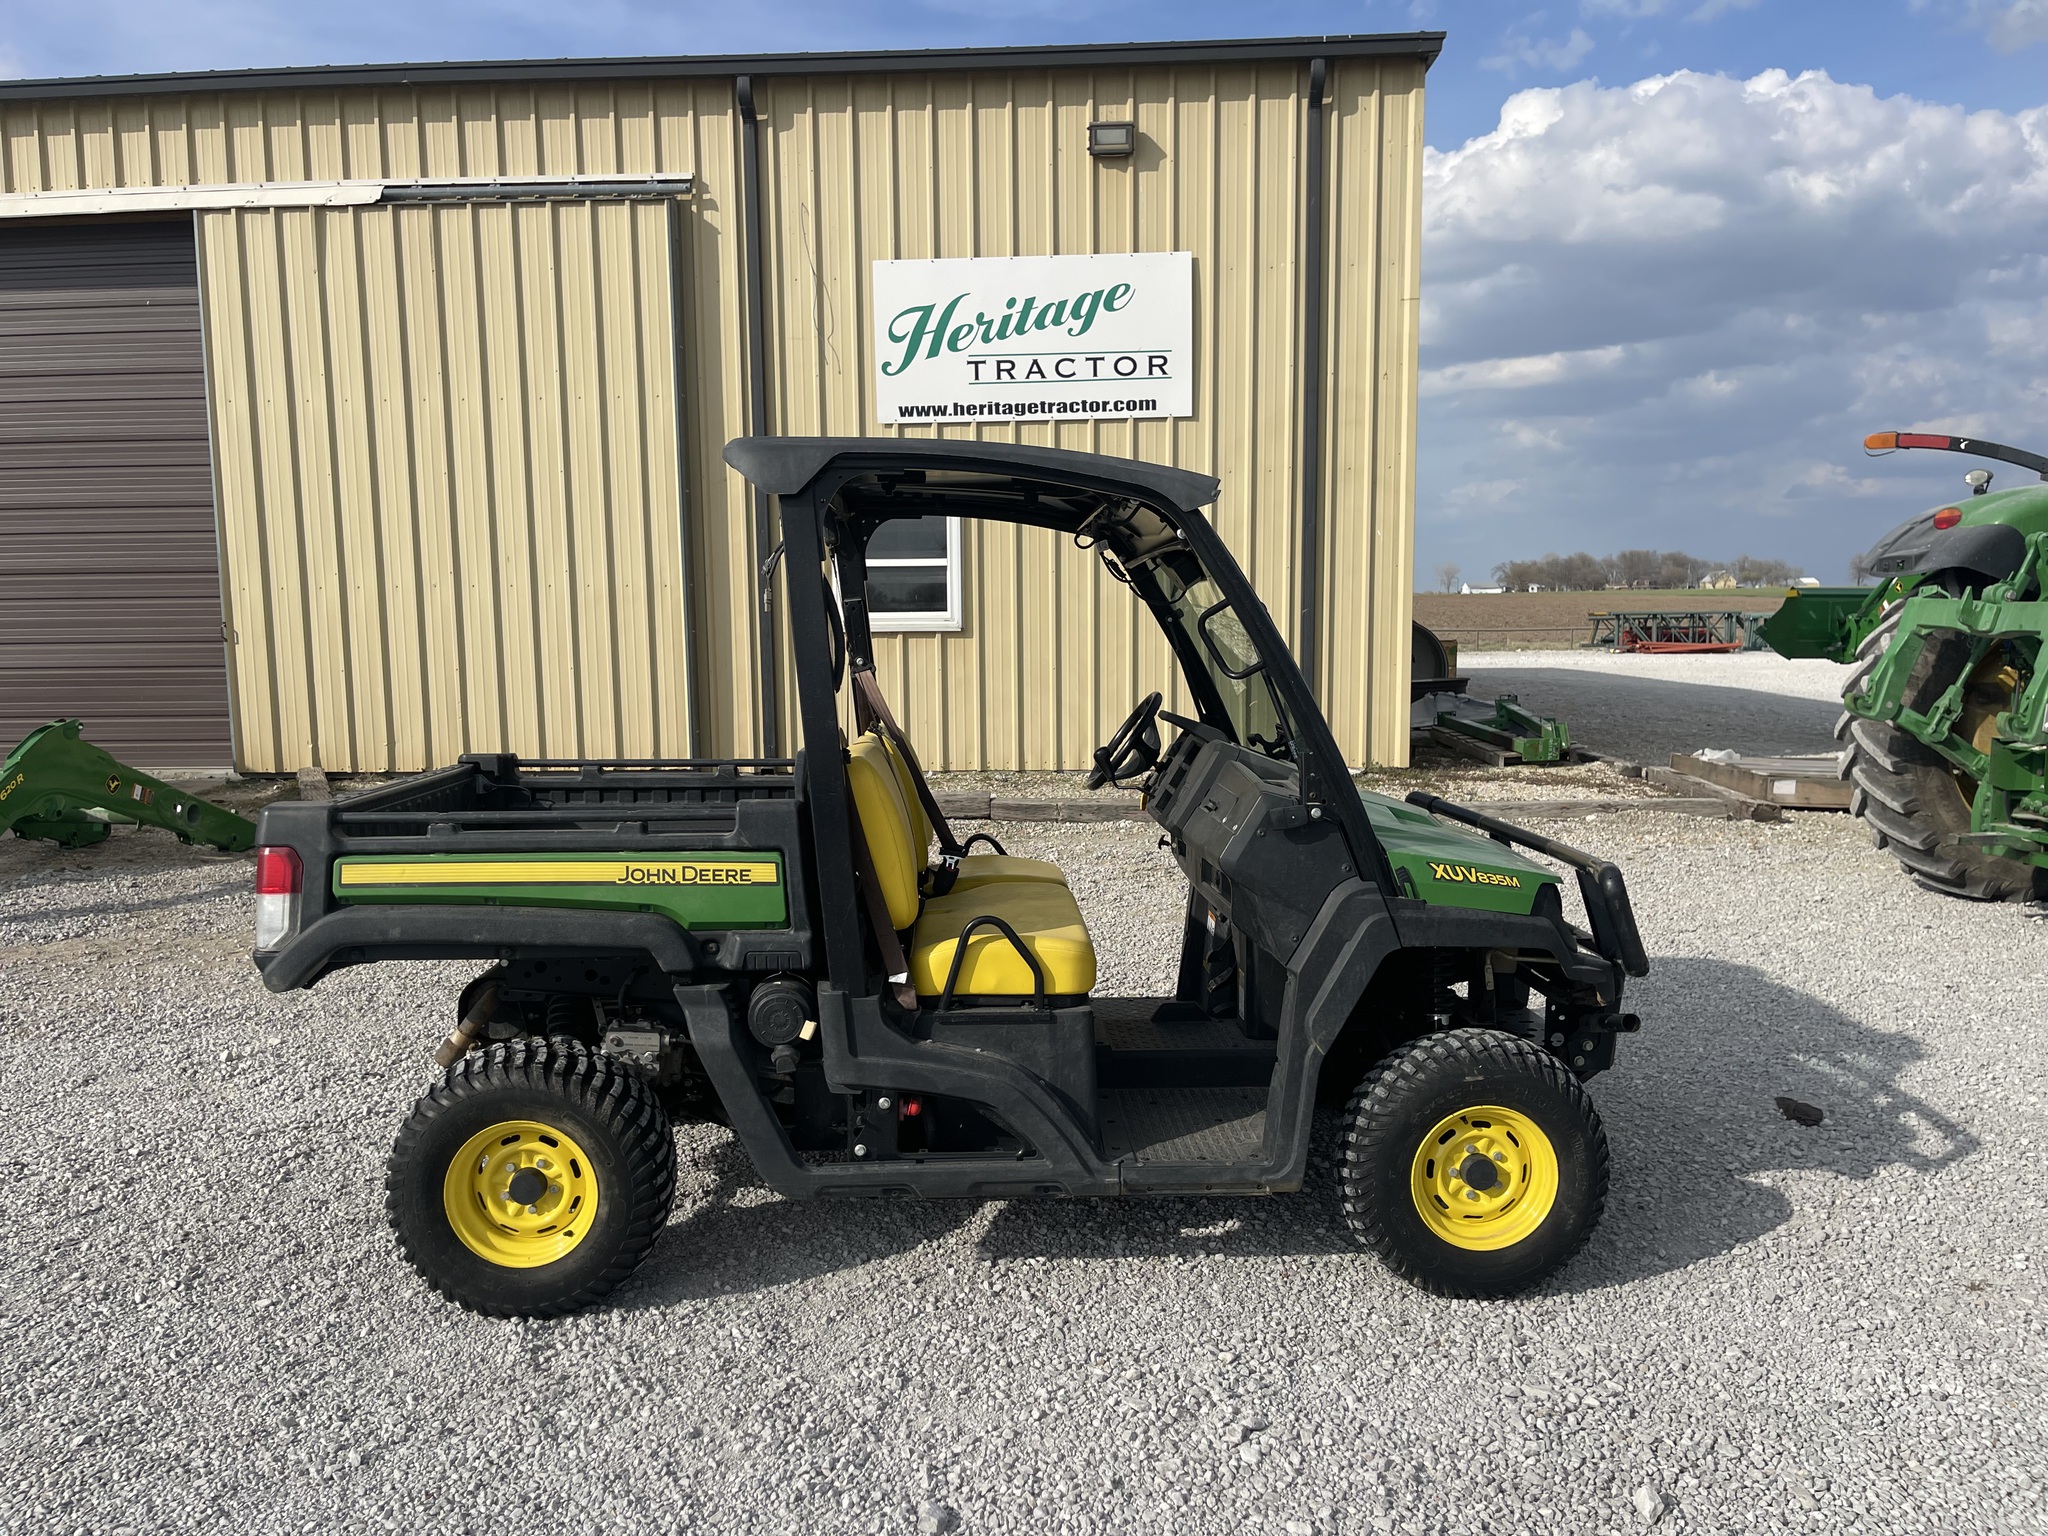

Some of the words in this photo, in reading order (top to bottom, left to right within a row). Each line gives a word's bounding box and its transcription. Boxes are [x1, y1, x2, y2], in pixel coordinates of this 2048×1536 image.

[881, 282, 1135, 376] Heritage
[967, 355, 1169, 381] TRACTOR
[898, 399, 1157, 417] www.heritagetractor.com
[618, 866, 676, 882] JOHN
[682, 866, 752, 882] DEERE
[1429, 862, 1521, 887] XUV835M
